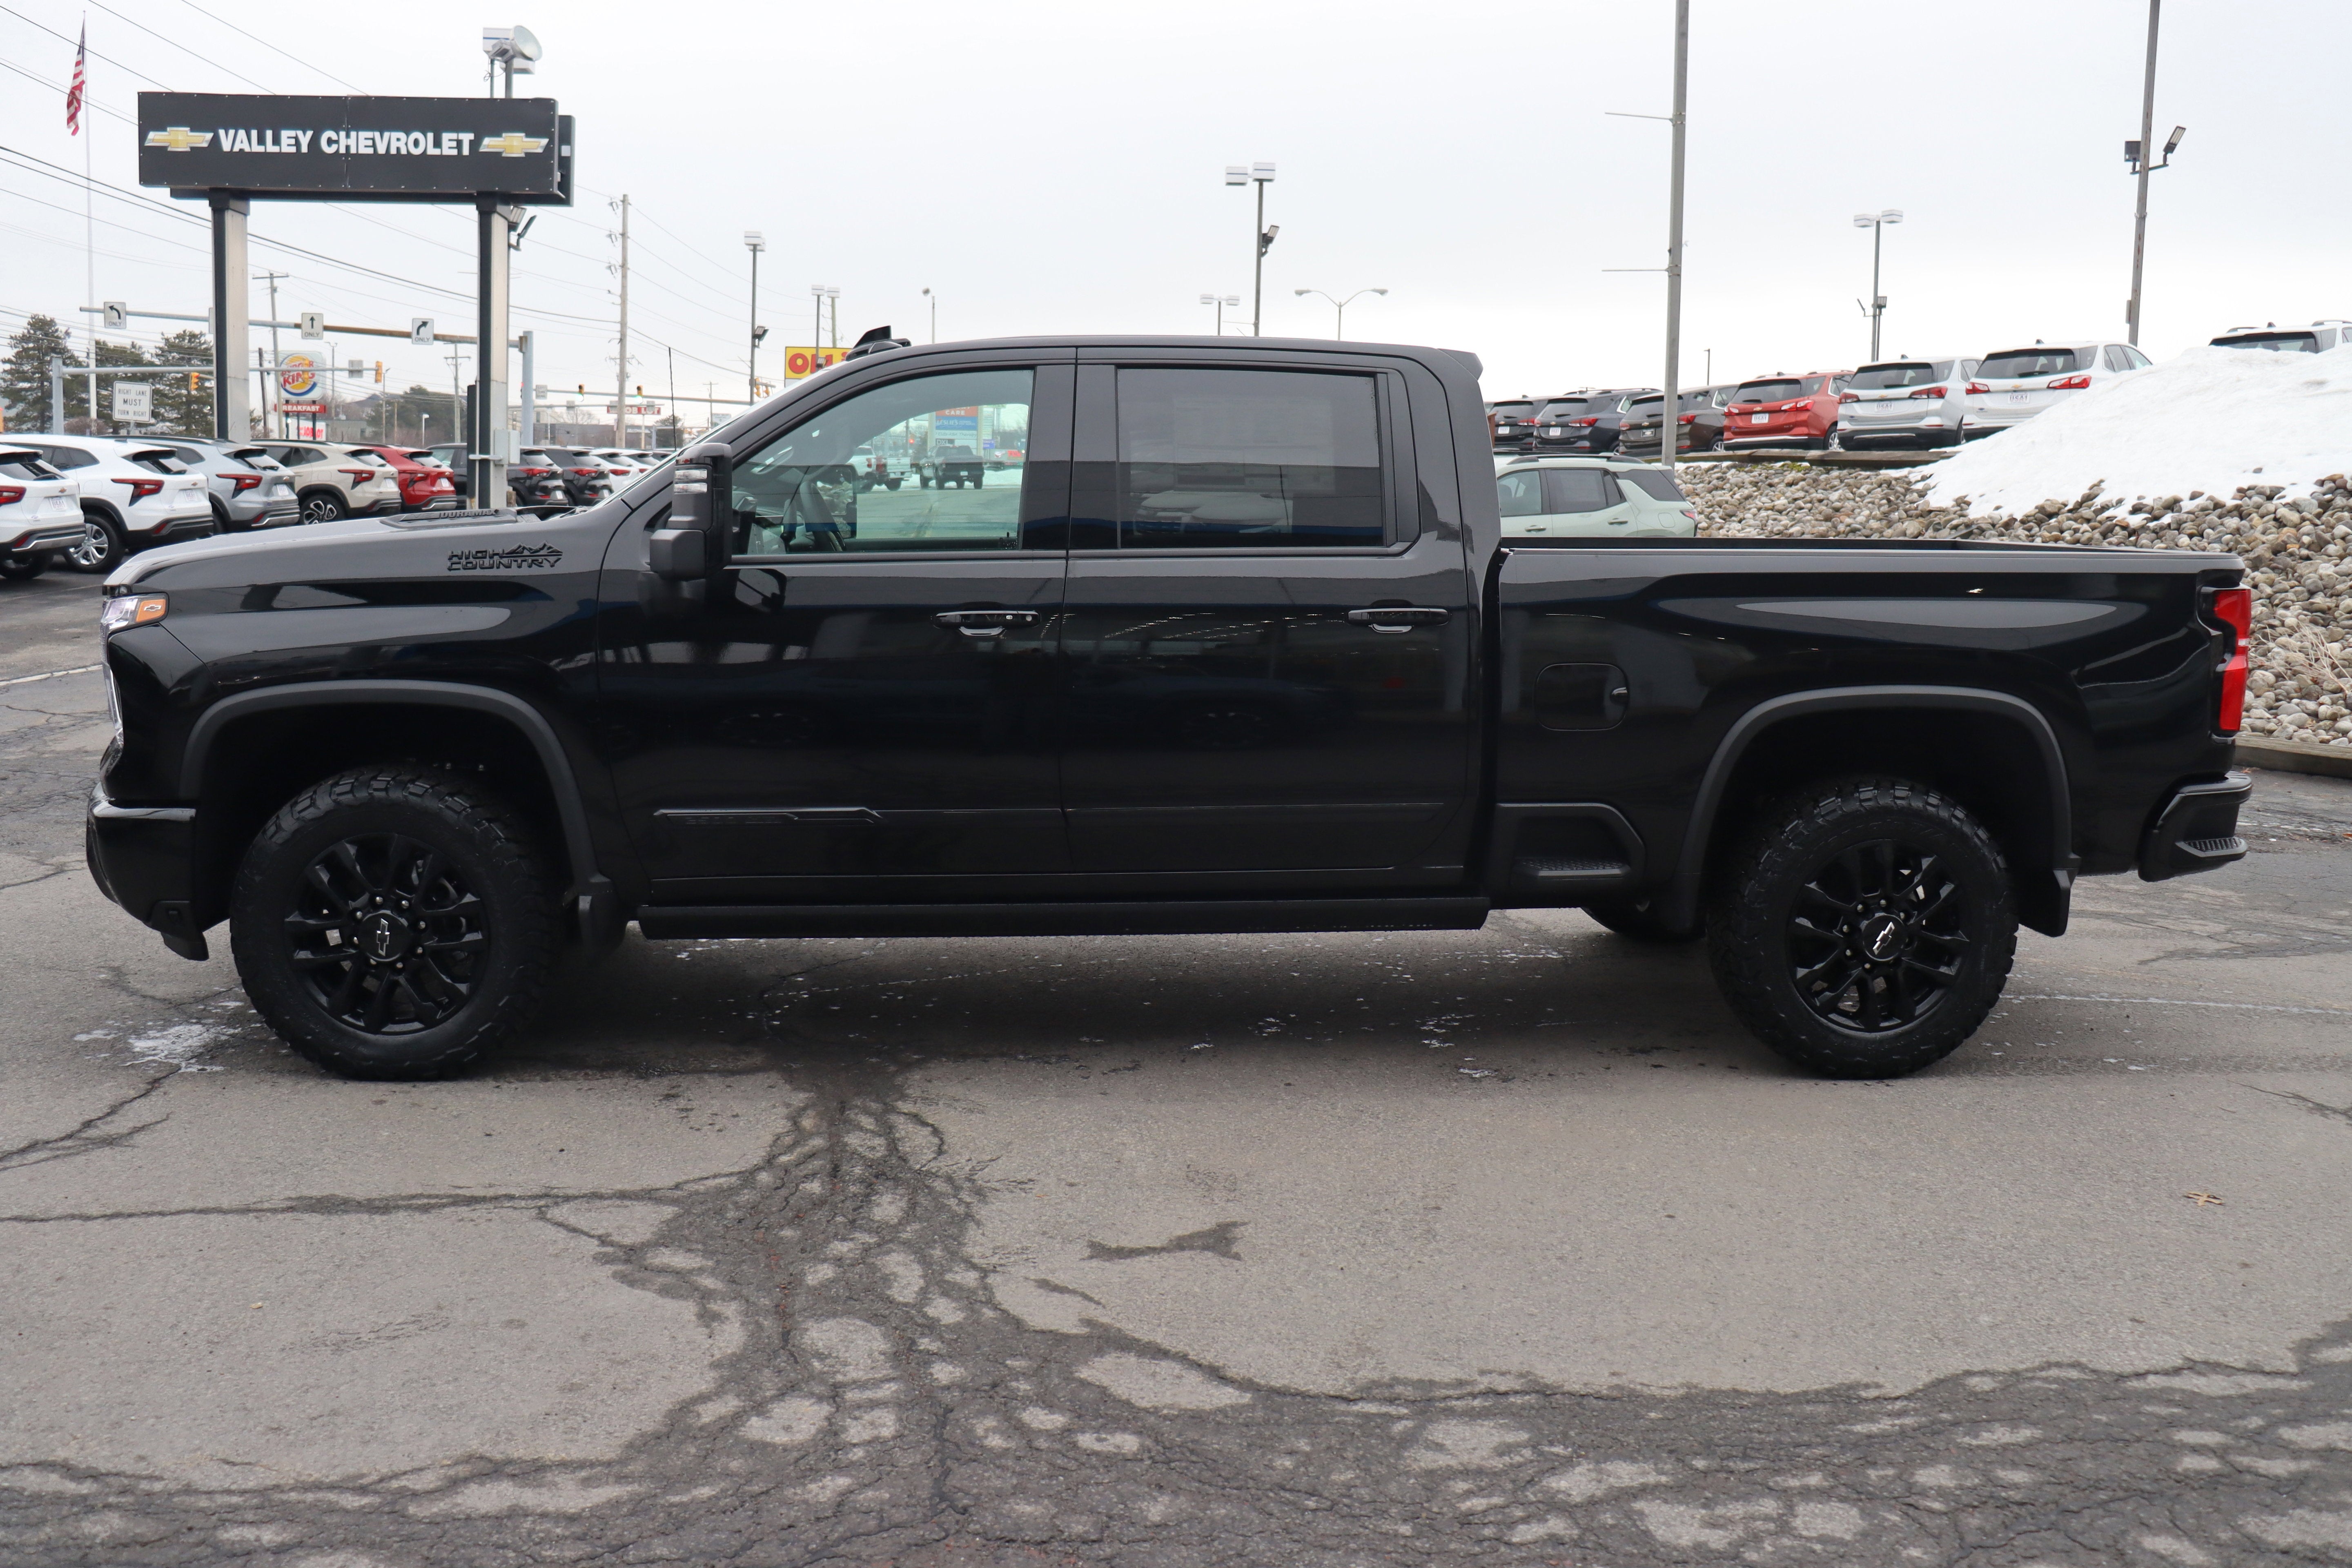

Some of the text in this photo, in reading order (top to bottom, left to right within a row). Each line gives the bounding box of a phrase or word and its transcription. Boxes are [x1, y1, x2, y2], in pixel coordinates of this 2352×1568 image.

[218, 129, 474, 156] VALLEY CHEVROLET
[123, 398, 142, 406] MUST
[440, 509, 497, 519] DURAMAX
[448, 548, 505, 560] HIGH
[447, 557, 563, 571] COUNTRY
